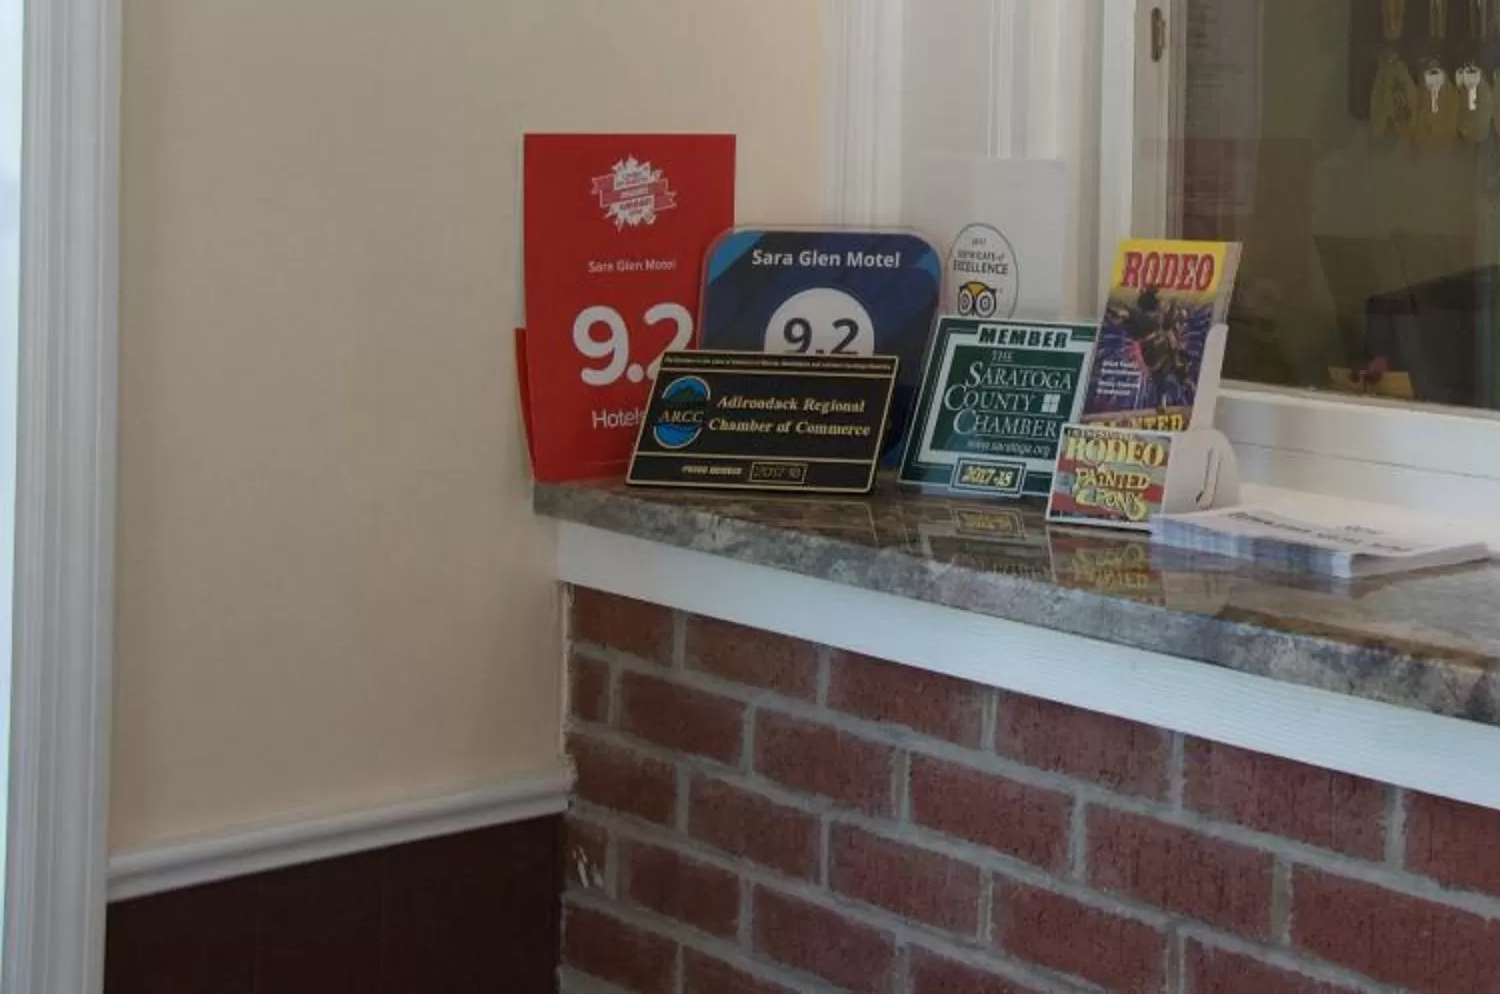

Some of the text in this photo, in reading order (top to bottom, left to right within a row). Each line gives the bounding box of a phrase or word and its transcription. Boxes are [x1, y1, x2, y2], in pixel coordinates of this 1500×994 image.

[587, 260, 614, 273] Sara
[645, 258, 677, 271] Motel
[752, 249, 901, 268] Sara Glen Motel
[1120, 251, 1215, 291] RODEO
[573, 302, 693, 386] 9.2
[783, 317, 859, 355] 9.2
[978, 327, 1068, 348] MEMBER
[991, 350, 1014, 361] THE
[965, 361, 1072, 390] SARATOGA
[716, 395, 866, 414] Adirondack Regional
[944, 383, 1036, 411] COUNTY
[708, 417, 871, 436] Chamber of Commerce
[953, 408, 1058, 437] CHAMBER
[1065, 437, 1164, 466] RODEO
[1075, 466, 1150, 490] PAINTED
